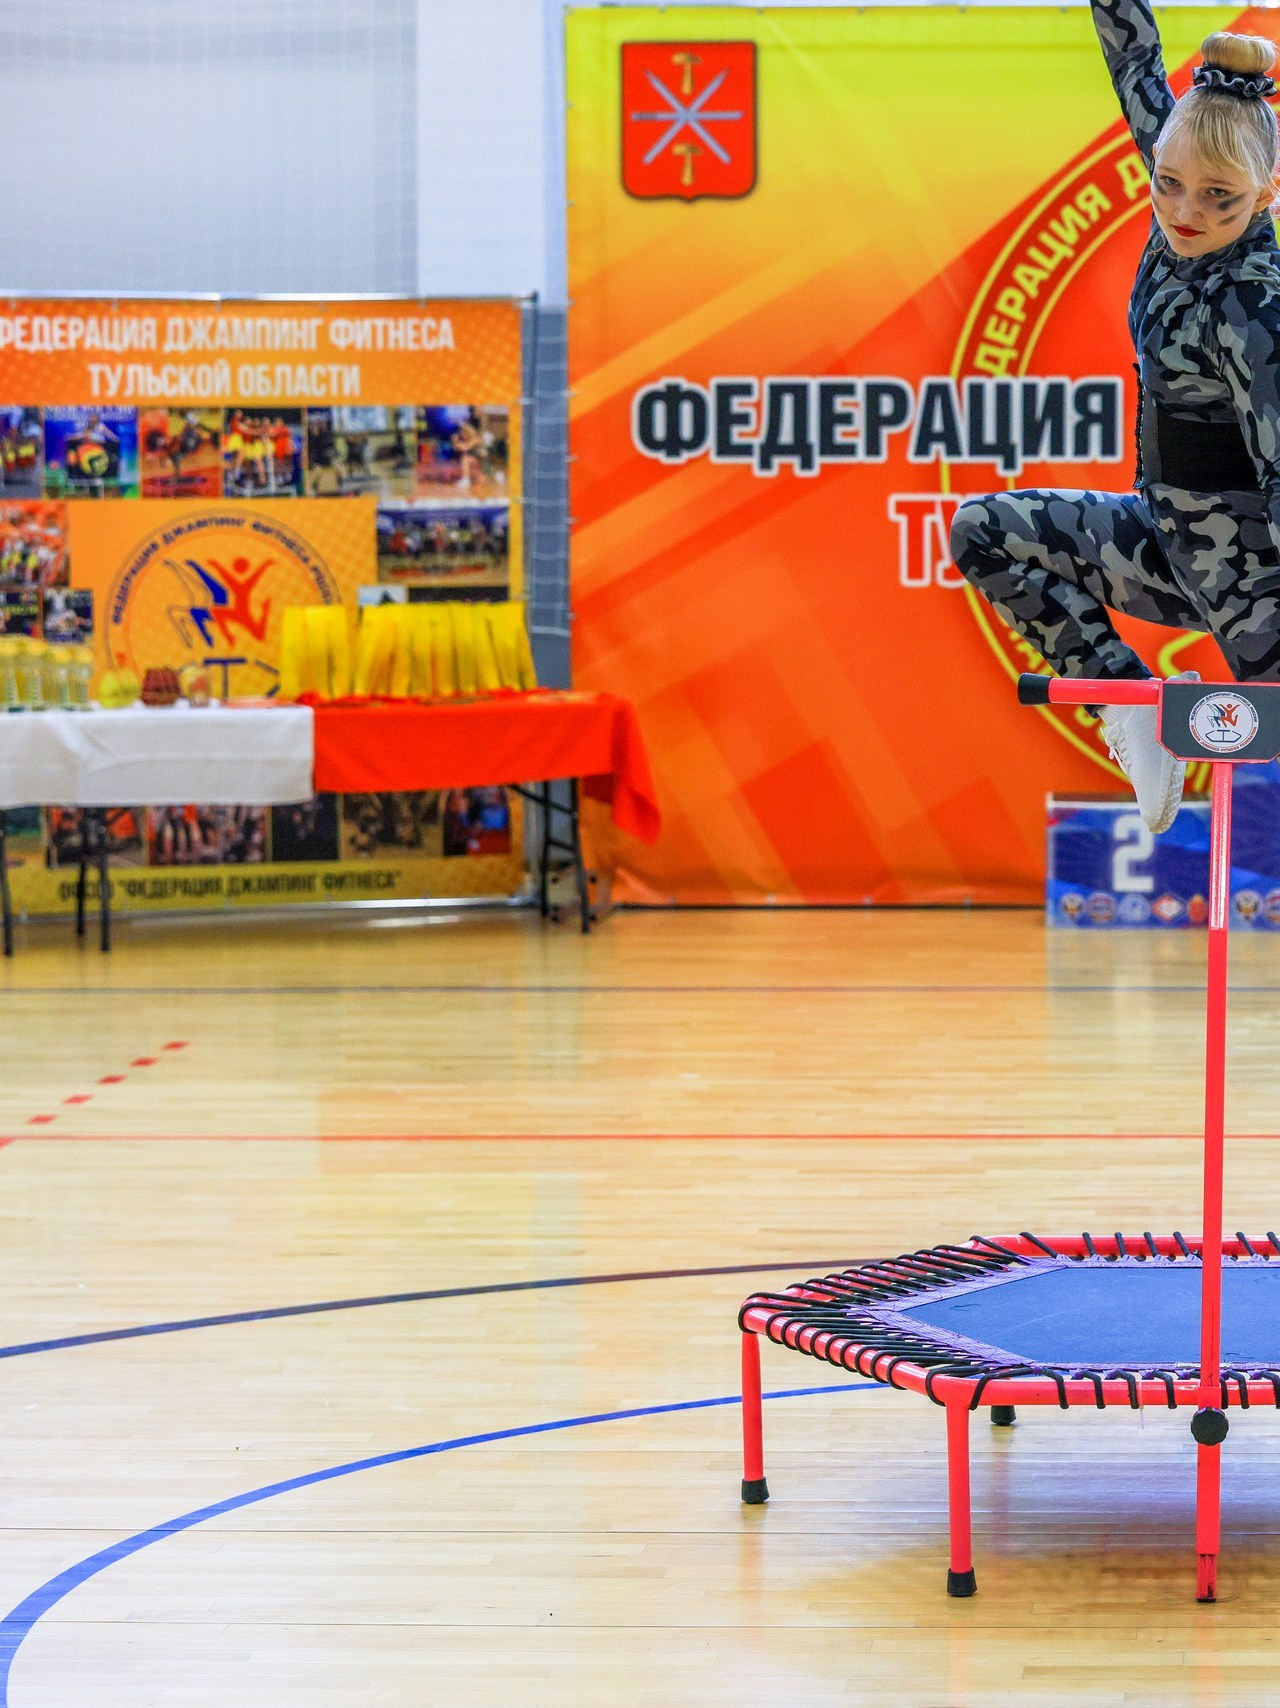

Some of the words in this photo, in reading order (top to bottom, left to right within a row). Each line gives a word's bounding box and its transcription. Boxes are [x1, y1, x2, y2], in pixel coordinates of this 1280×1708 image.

[973, 182, 1112, 378] ДЕРАЦИЯ
[163, 317, 322, 353] ДЖАМПИНГ
[328, 317, 455, 351] ФИТНЕСА
[88, 360, 232, 398] ТУЛЬСКОЙ
[238, 364, 361, 398] ОБЛАСТИ
[633, 377, 1123, 475] ФЕДЕРАЦИЯ
[1112, 814, 1156, 893] 2
